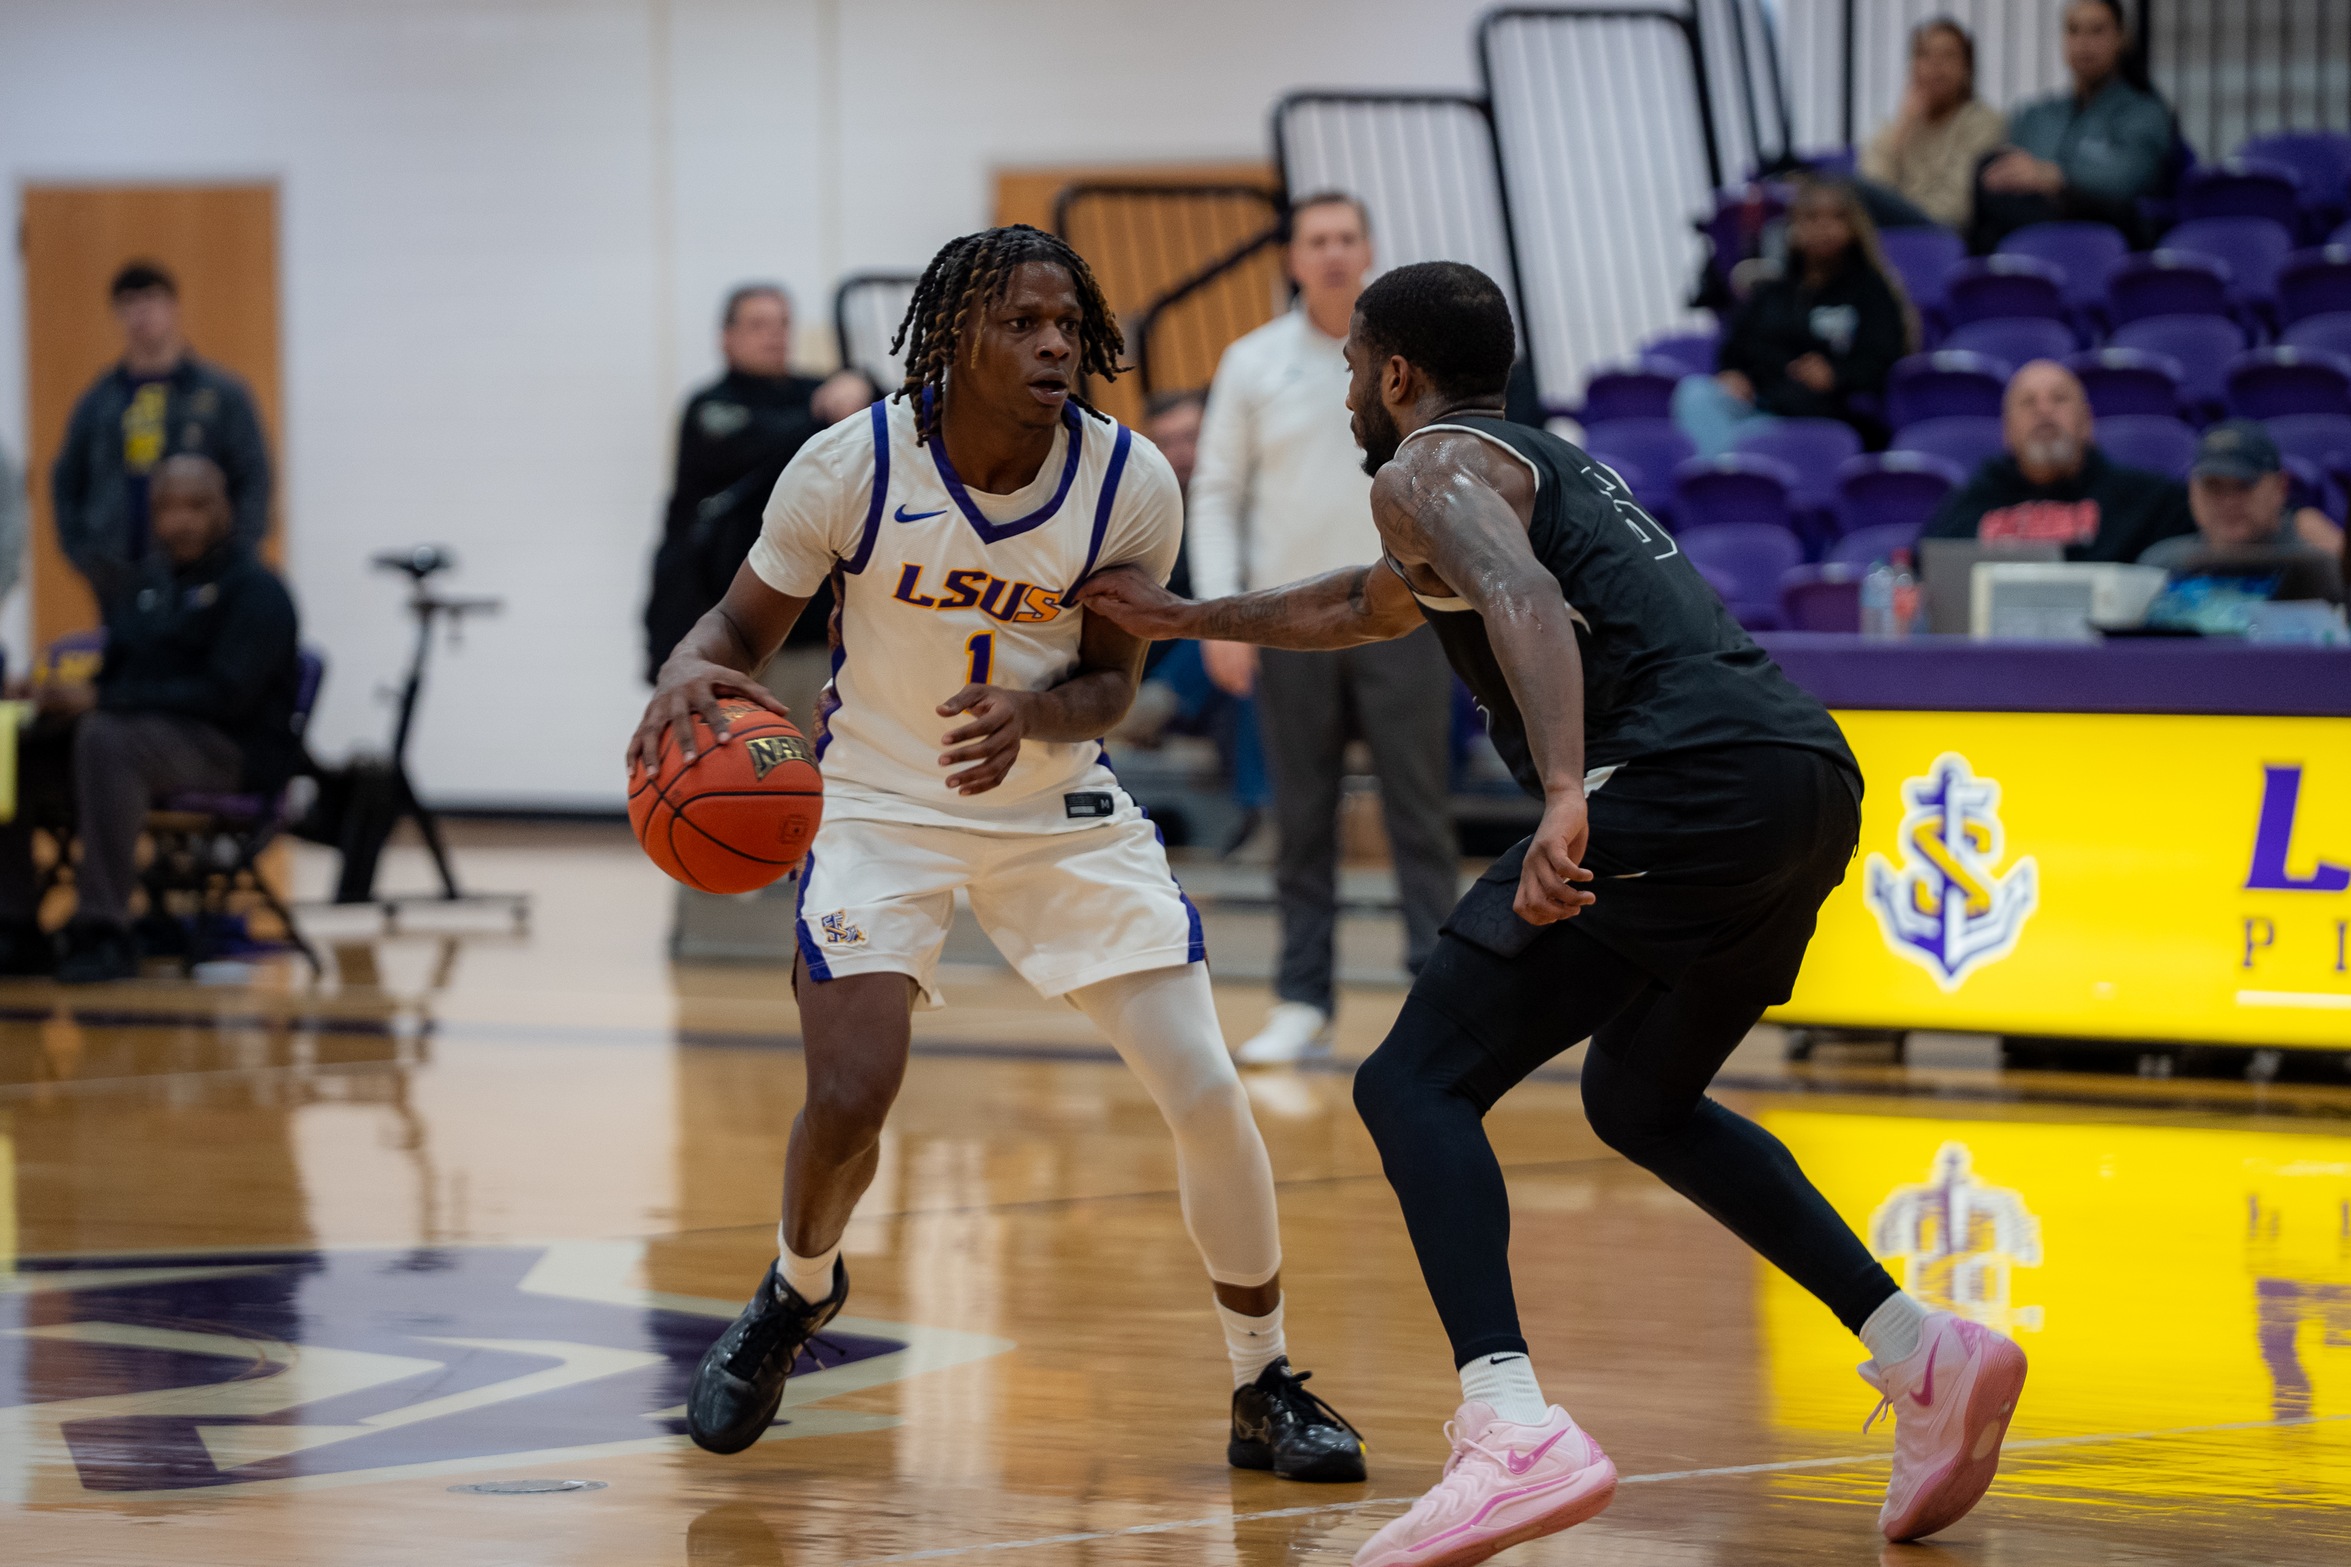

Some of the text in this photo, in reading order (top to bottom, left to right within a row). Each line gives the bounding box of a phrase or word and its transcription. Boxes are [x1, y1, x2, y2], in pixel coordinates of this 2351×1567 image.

[893, 562, 1064, 623] LSUS
[964, 629, 996, 715] 1
[2244, 763, 2351, 892] L
